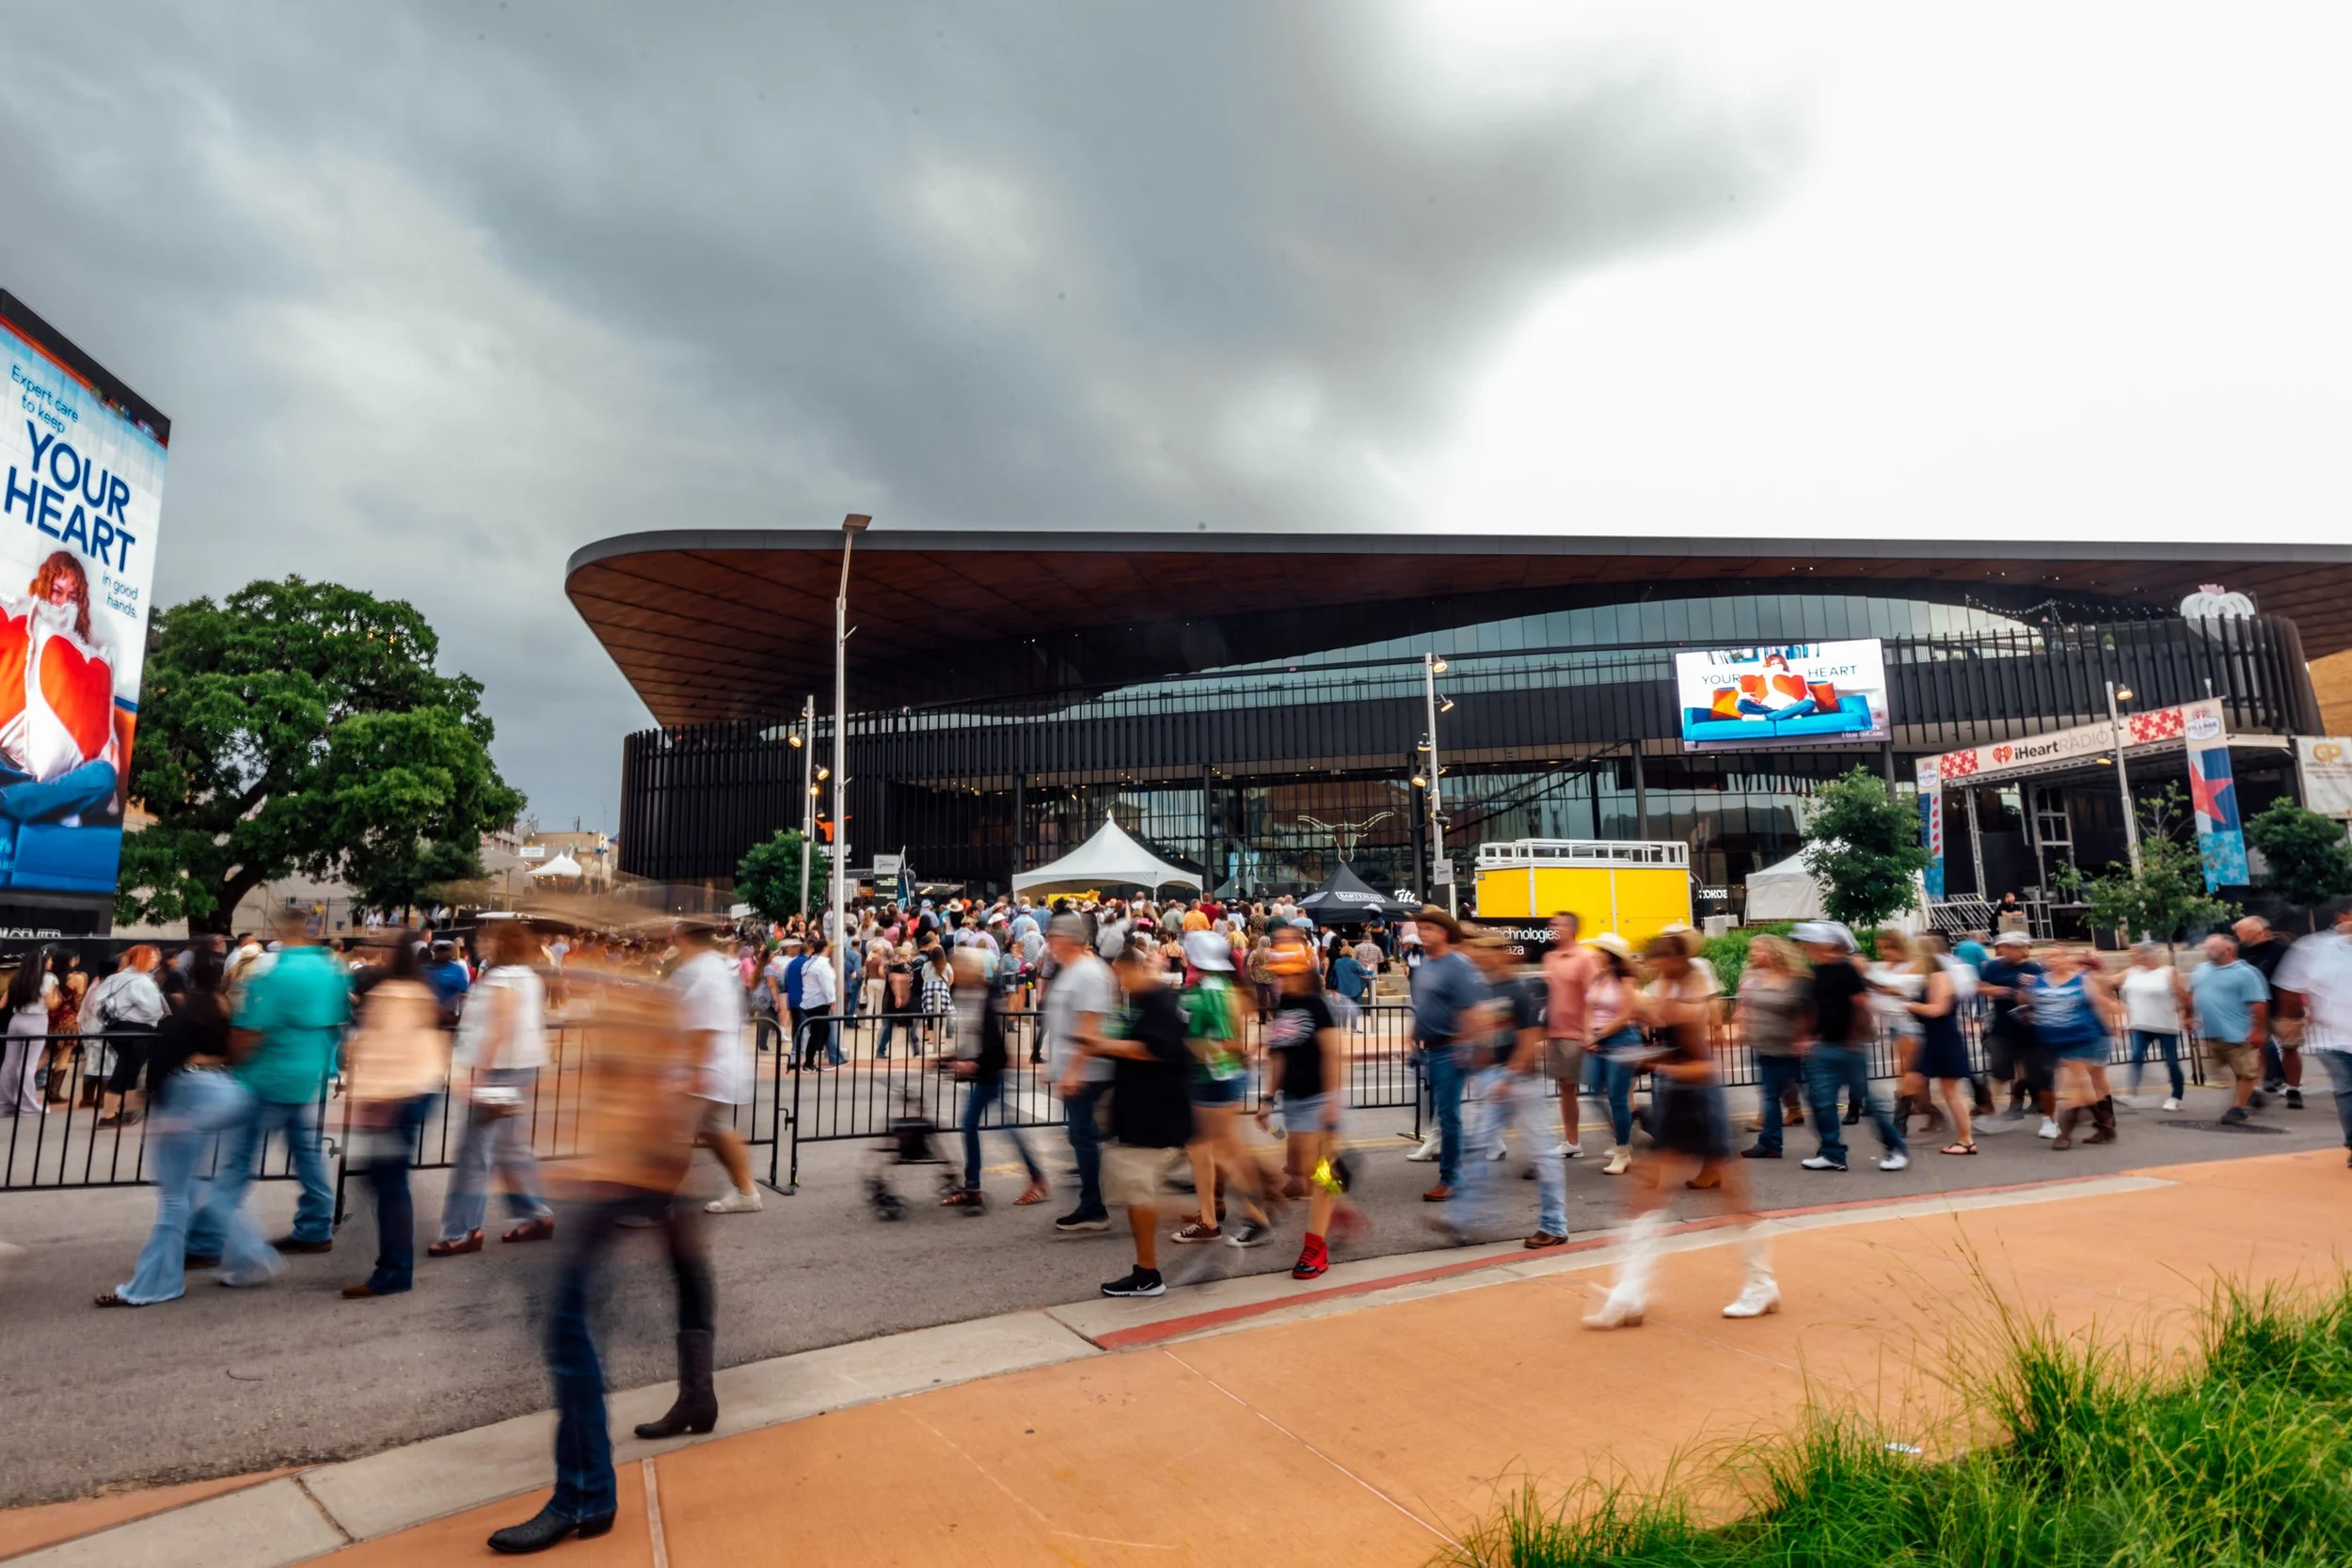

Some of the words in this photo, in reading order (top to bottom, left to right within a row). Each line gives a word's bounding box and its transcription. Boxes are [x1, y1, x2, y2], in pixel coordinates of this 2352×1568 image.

[11, 364, 53, 400] Expert
[56, 398, 79, 423] care
[22, 394, 35, 413] to
[38, 404, 65, 435] keep
[26, 420, 130, 525] YOUR
[4, 466, 136, 574] HEART
[103, 571, 112, 587] in
[113, 578, 139, 602] good
[106, 593, 138, 619] hands.
[1701, 673, 1740, 686] YOUR
[1807, 665, 1858, 678] HEART
